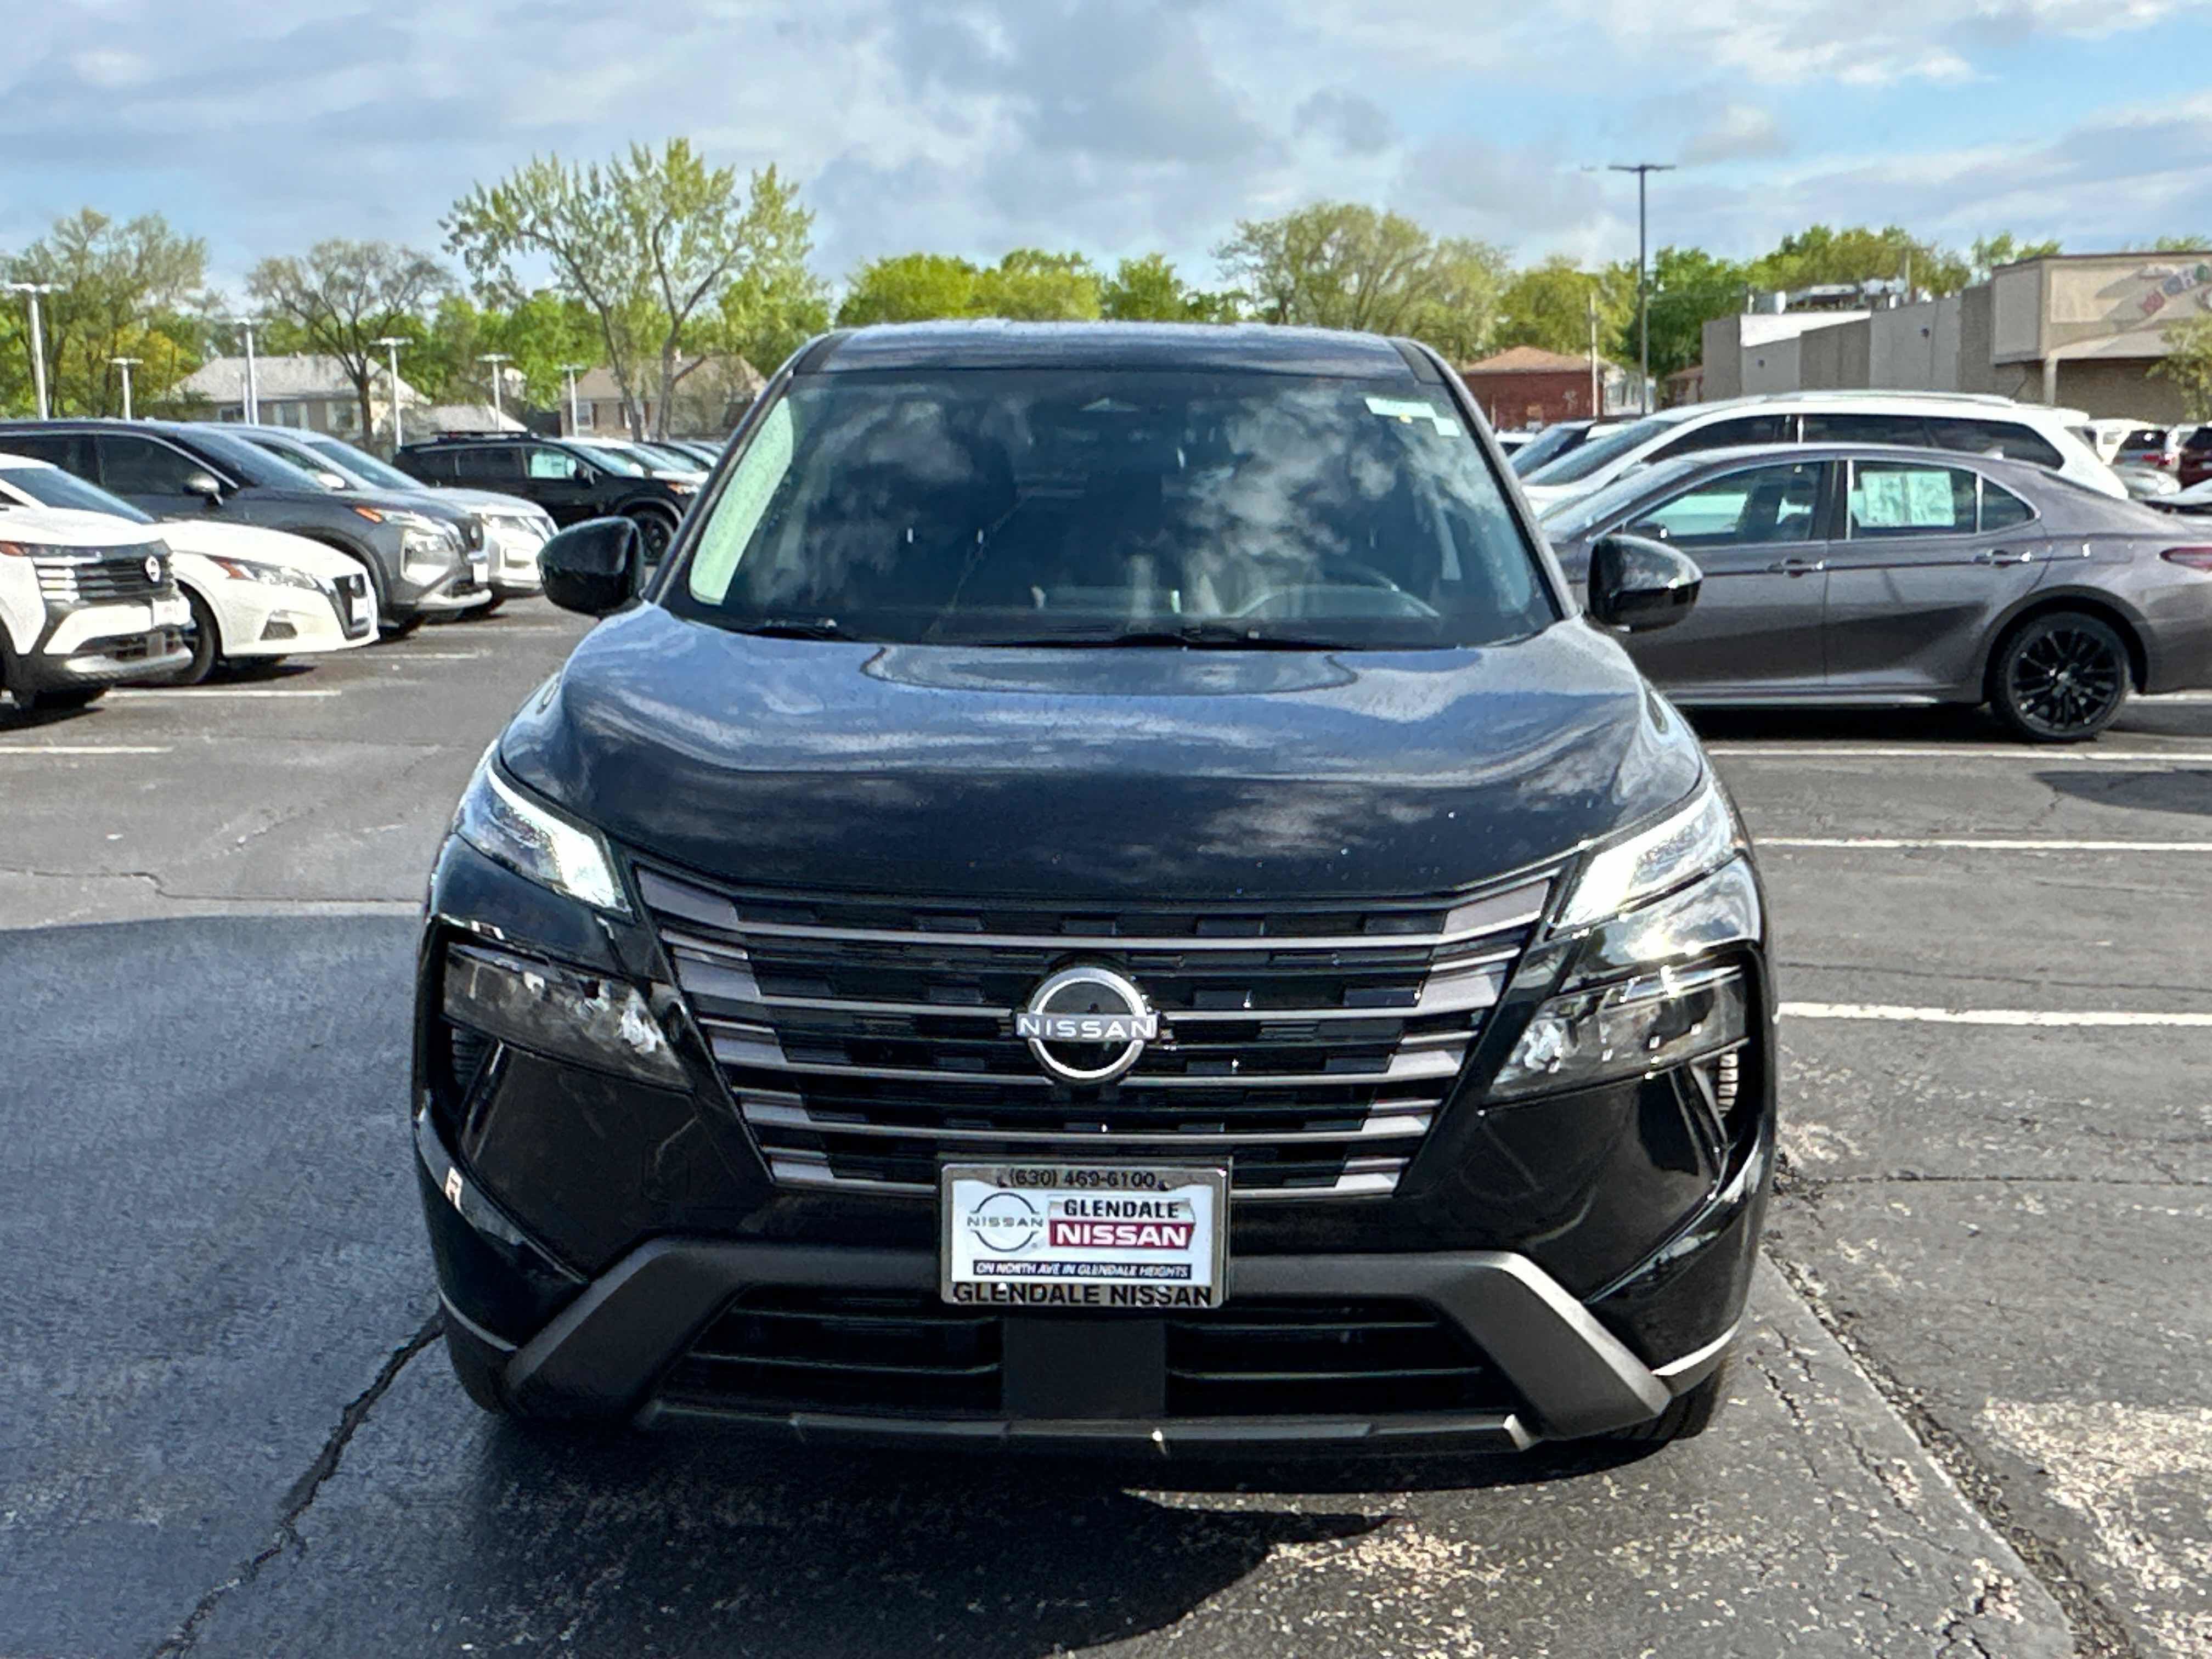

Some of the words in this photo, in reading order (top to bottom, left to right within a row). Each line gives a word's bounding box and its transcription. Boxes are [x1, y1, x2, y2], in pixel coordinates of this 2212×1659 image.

[1019, 1018, 1151, 1038] NISSAN
[1010, 1169, 1058, 1187] (630)
[1064, 1170, 1156, 1188] 469-6100
[1063, 1199, 1180, 1219] GLENDALE
[967, 1216, 1043, 1228] NISSAN
[1056, 1223, 1187, 1247] NISSAN
[977, 1262, 995, 1274] ON
[996, 1263, 1036, 1274] NORTH
[1037, 1263, 1060, 1274] AVE
[1062, 1264, 1076, 1275] IN
[1077, 1264, 1138, 1276] GLENDALE
[1139, 1265, 1188, 1278] HEIGHTS
[952, 1282, 1100, 1303] GLENDALE
[1110, 1284, 1212, 1306] NISSAN
